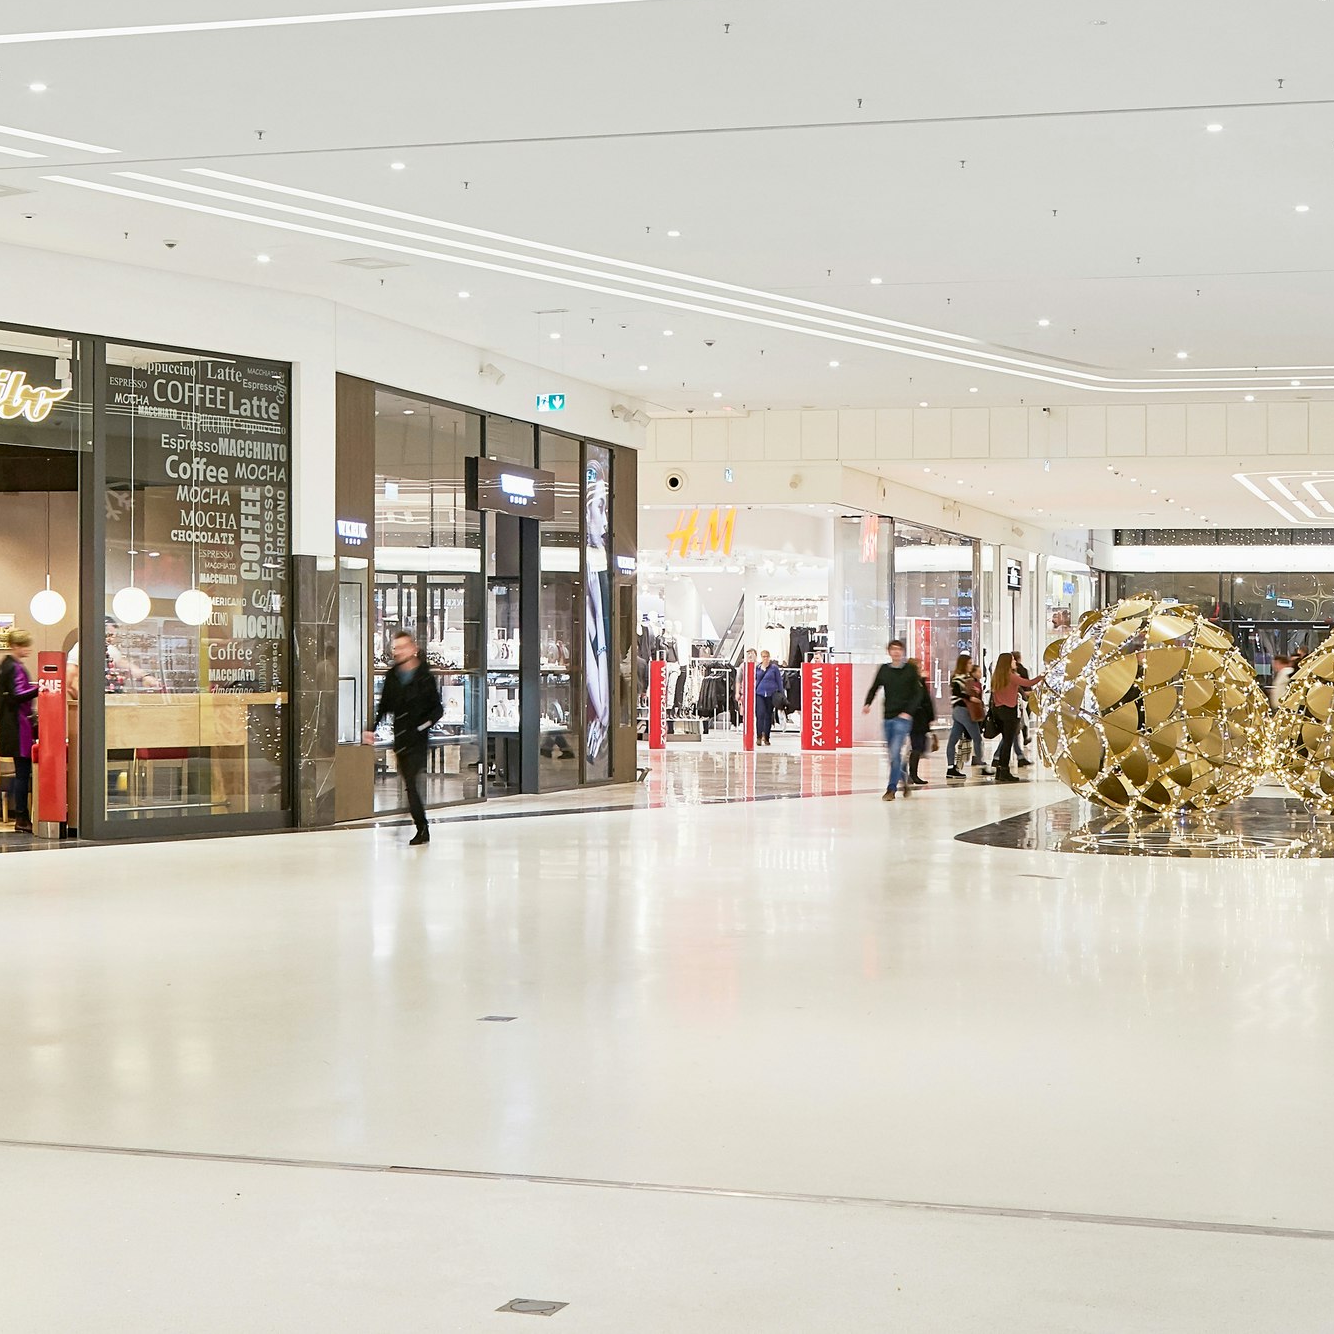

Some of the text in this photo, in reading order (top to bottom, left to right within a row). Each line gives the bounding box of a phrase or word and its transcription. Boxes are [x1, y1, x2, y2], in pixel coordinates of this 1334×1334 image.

[206, 362, 243, 382] Latte
[109, 377, 147, 389] ESPRESSO
[242, 378, 278, 393] Espresso
[114, 393, 150, 406] MOCHA
[153, 379, 226, 409] COFFEE
[228, 391, 280, 420] Latte
[161, 433, 218, 453] Espresso
[218, 437, 287, 462] MACCHIATO
[165, 455, 229, 484] Coffee
[235, 462, 286, 482] MOCHA
[176, 485, 230, 506] MOCHA
[180, 509, 237, 530] MOCHA
[171, 530, 235, 545] CHOCOLATE
[240, 486, 260, 580] COFFEE
[262, 485, 278, 581] Espresso
[276, 490, 286, 580] AMERICANO
[666, 506, 737, 559] H&M
[199, 549, 233, 560] ESPRESSO
[199, 573, 237, 585] MACCHIATO
[208, 597, 247, 607] MERICANO
[252, 588, 286, 613] Coffe
[204, 612, 228, 626] UCCINO
[232, 615, 286, 639] MOCHA
[208, 642, 253, 661] Coffee
[208, 668, 256, 682] MACCHIATO
[39, 678, 62, 694] SALE
[811, 667, 825, 747] WYPRZEDAŻ
